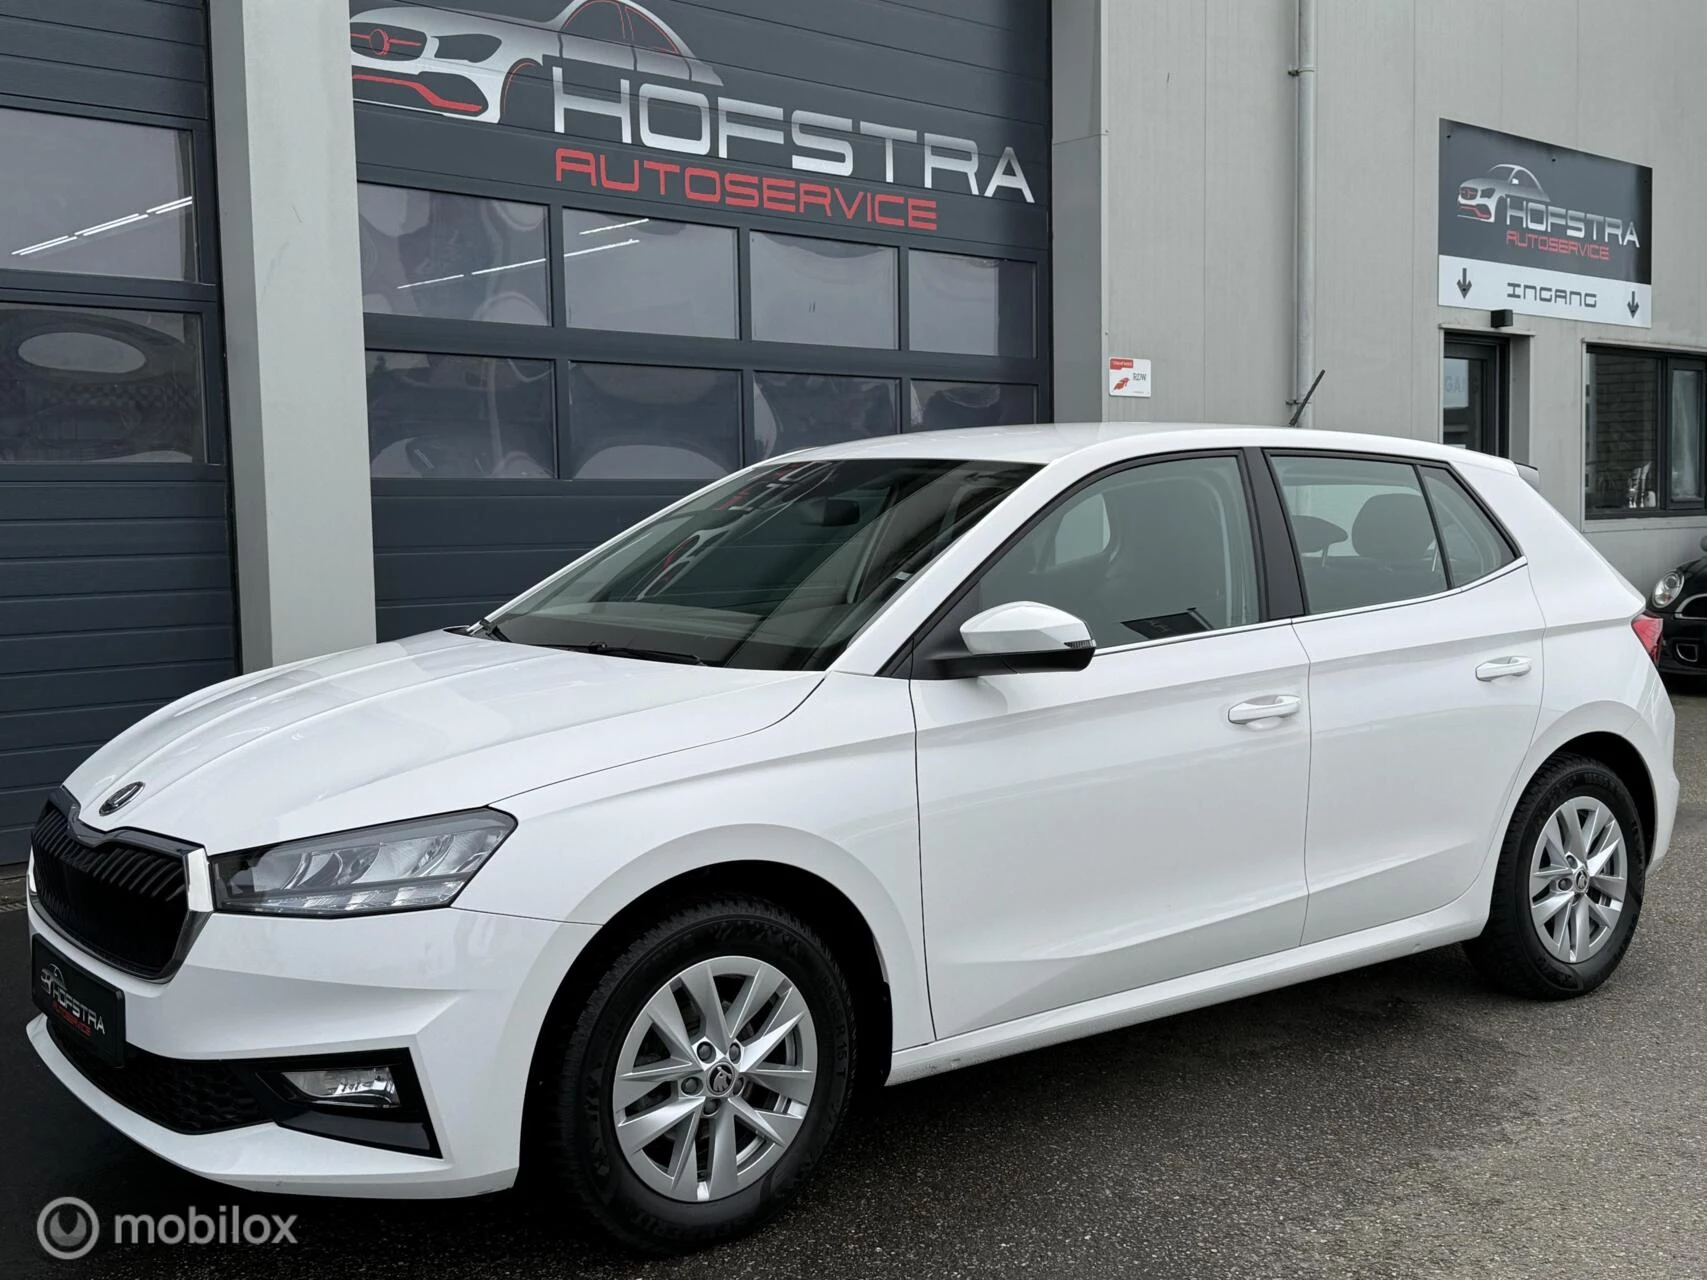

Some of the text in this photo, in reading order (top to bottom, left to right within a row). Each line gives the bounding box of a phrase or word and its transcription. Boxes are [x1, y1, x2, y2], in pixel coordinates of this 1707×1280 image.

[552, 66, 1034, 204] HOFSTRA
[555, 147, 937, 231] AUTOSERVICE
[1506, 198, 1640, 248] HOFSTRA
[1506, 230, 1610, 261] AUTOSERVICE
[1507, 281, 1597, 308] INGANG
[53, 983, 106, 1035] HOFSTRA
